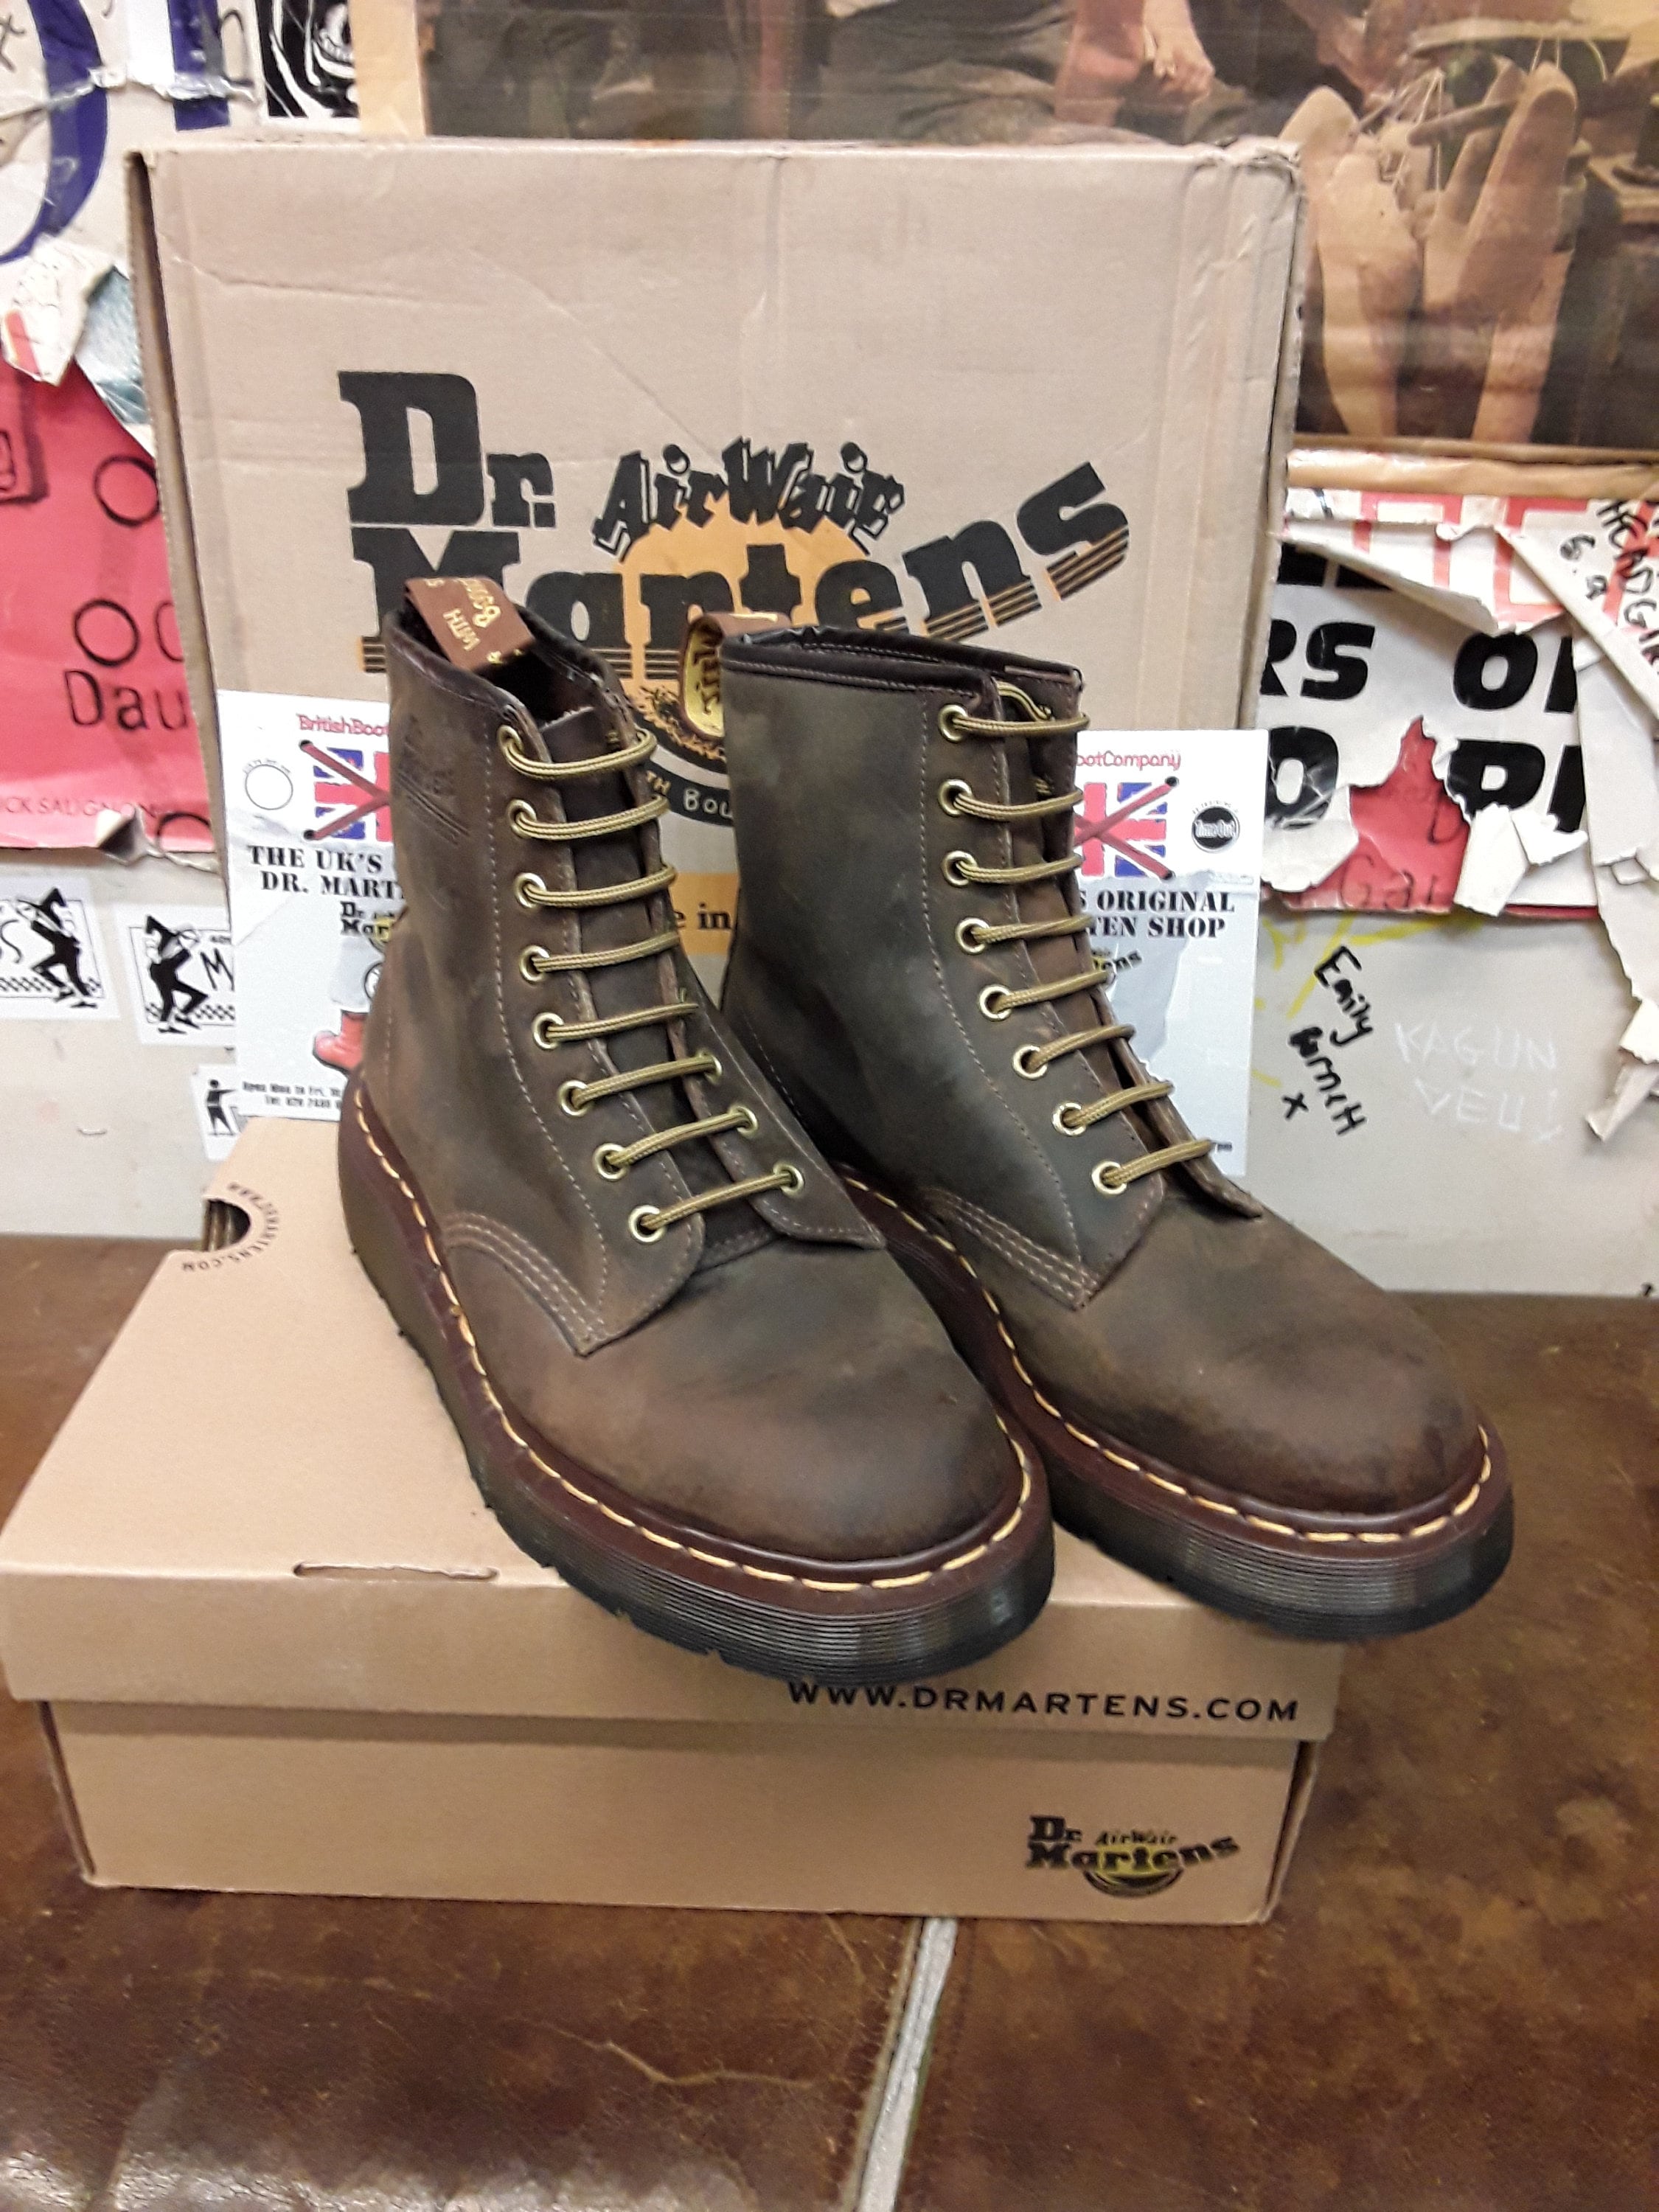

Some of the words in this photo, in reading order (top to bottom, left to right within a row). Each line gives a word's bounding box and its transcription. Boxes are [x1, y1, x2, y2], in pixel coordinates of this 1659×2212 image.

[592, 438, 905, 563] AirWair
[351, 459, 1130, 672] Martens
[247, 845, 305, 869] THE
[316, 849, 382, 874] UK'S
[260, 871, 309, 894] DR.
[1097, 890, 1235, 913] ORIGINAL
[1148, 917, 1225, 938] SHOP
[1313, 945, 1374, 1048] Emily
[787, 1680, 1299, 1722] WWW.DRMARTENS.COM
[1026, 1836, 1240, 1870] Martens
